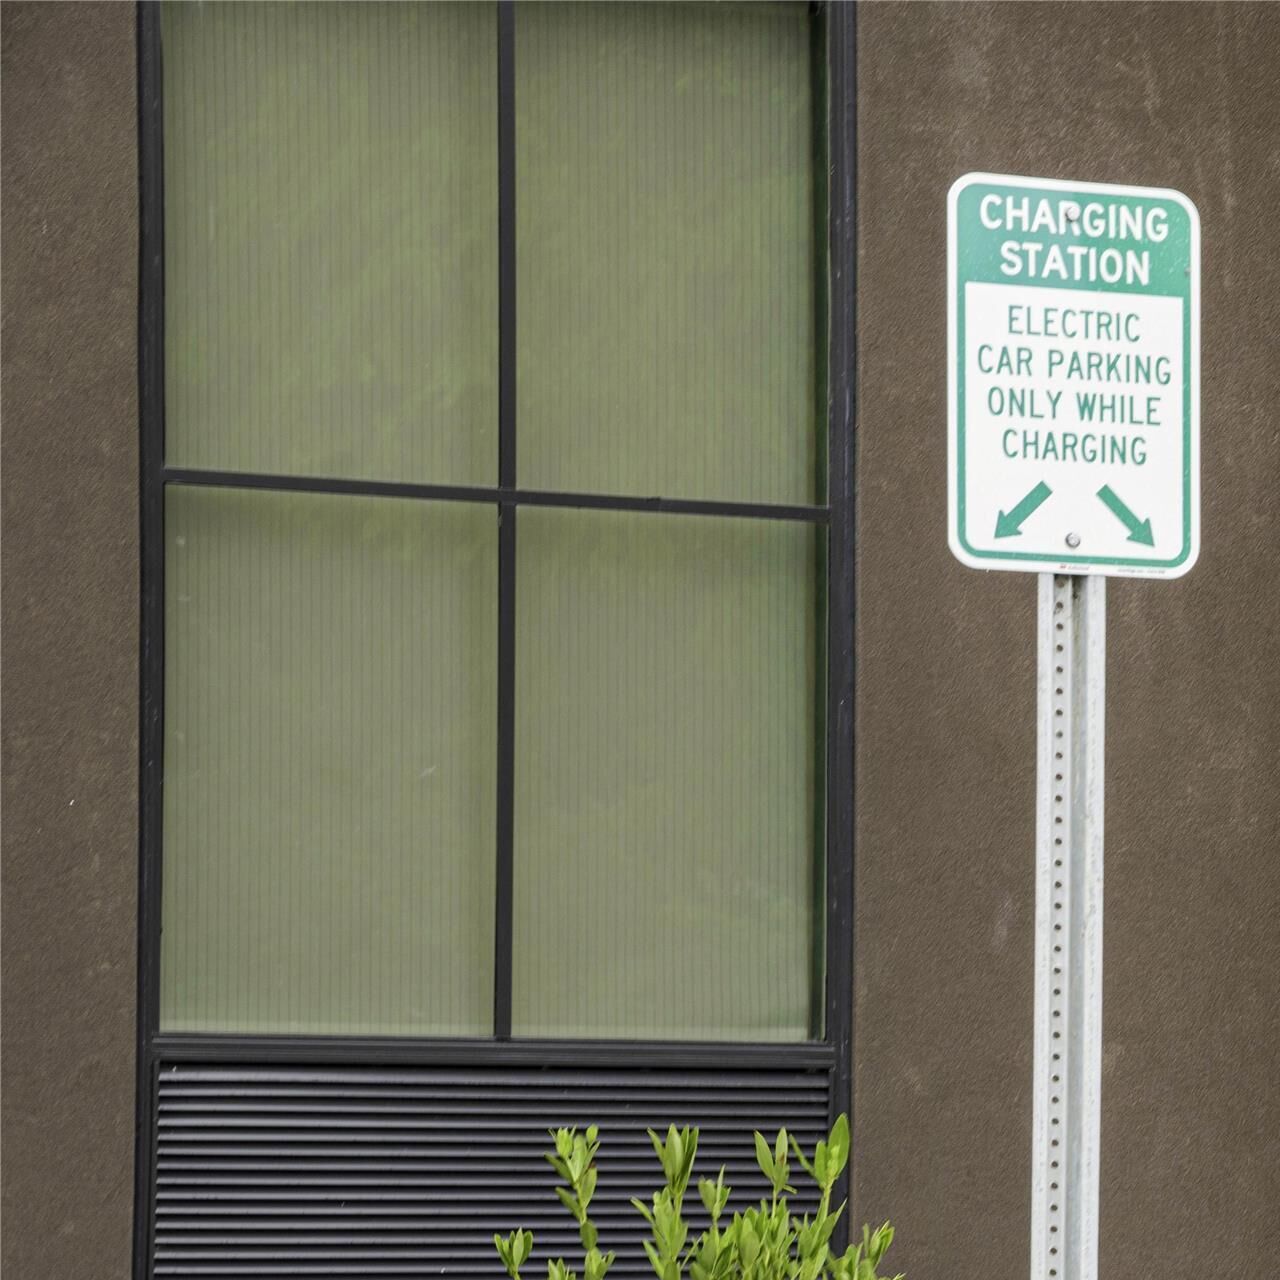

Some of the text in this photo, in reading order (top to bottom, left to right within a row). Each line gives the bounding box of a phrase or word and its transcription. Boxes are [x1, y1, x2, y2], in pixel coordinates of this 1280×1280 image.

[980, 193, 1169, 243] CHARGING
[1000, 240, 1150, 286] STATION
[1008, 305, 1141, 343] ELECTRIC
[977, 344, 1171, 386] CAR PARKING
[987, 386, 1162, 426] ONLY WHILE
[1002, 429, 1147, 466] CHARGING
